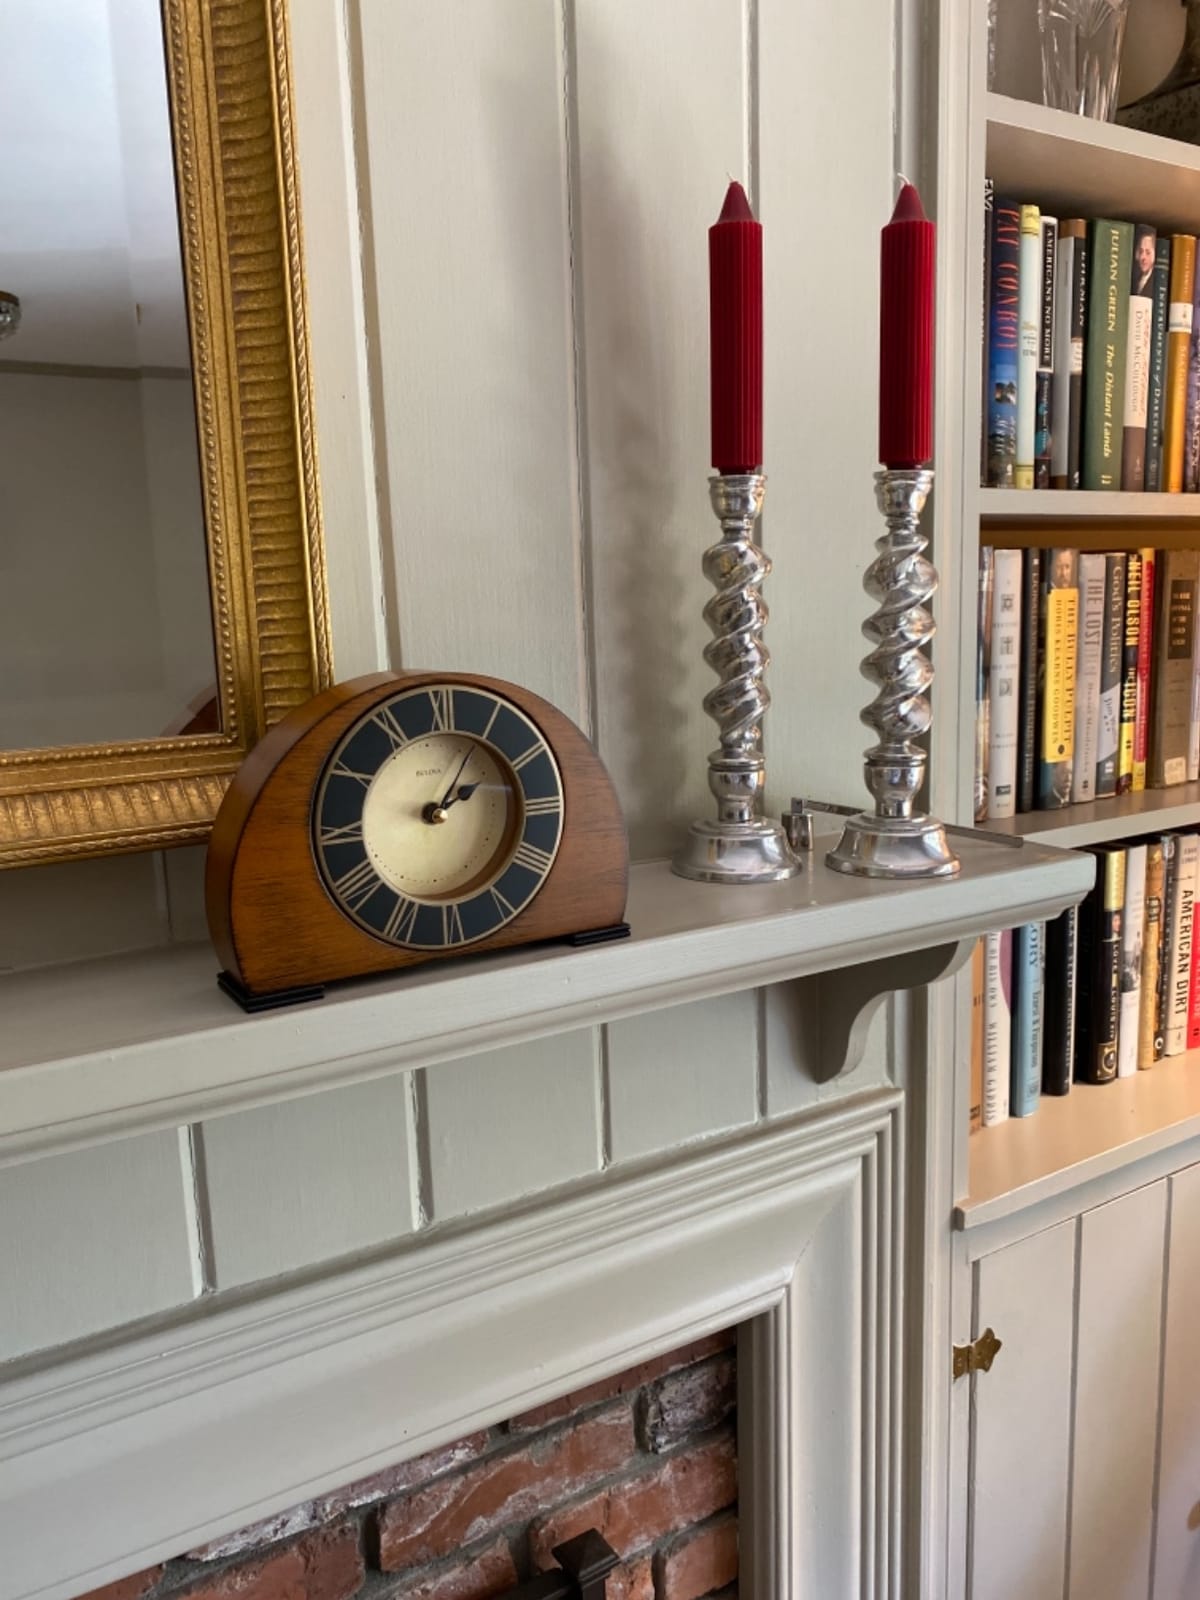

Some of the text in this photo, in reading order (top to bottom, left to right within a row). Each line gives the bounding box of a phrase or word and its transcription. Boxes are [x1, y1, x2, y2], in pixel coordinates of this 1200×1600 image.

[996, 208, 1019, 350] PAT CONROY
[1043, 229, 1055, 361] AMERICANS NO MORE
[1103, 229, 1120, 458] JULIAN GREEN The Distant Lands
[1084, 610, 1102, 647] LOST
[1087, 578, 1105, 605] THE
[1110, 566, 1123, 673] God's Politics
[1125, 600, 1140, 647] OLSON
[1127, 561, 1141, 594] NEIL
[1052, 599, 1063, 744] DORIS KEARNS GOODWIN
[1063, 599, 1076, 744] THE BULLY PULPIT
[1122, 681, 1136, 720] ICON
[1029, 924, 1039, 968] ORY
[1175, 890, 1194, 1014] AMERICAN DIRT
